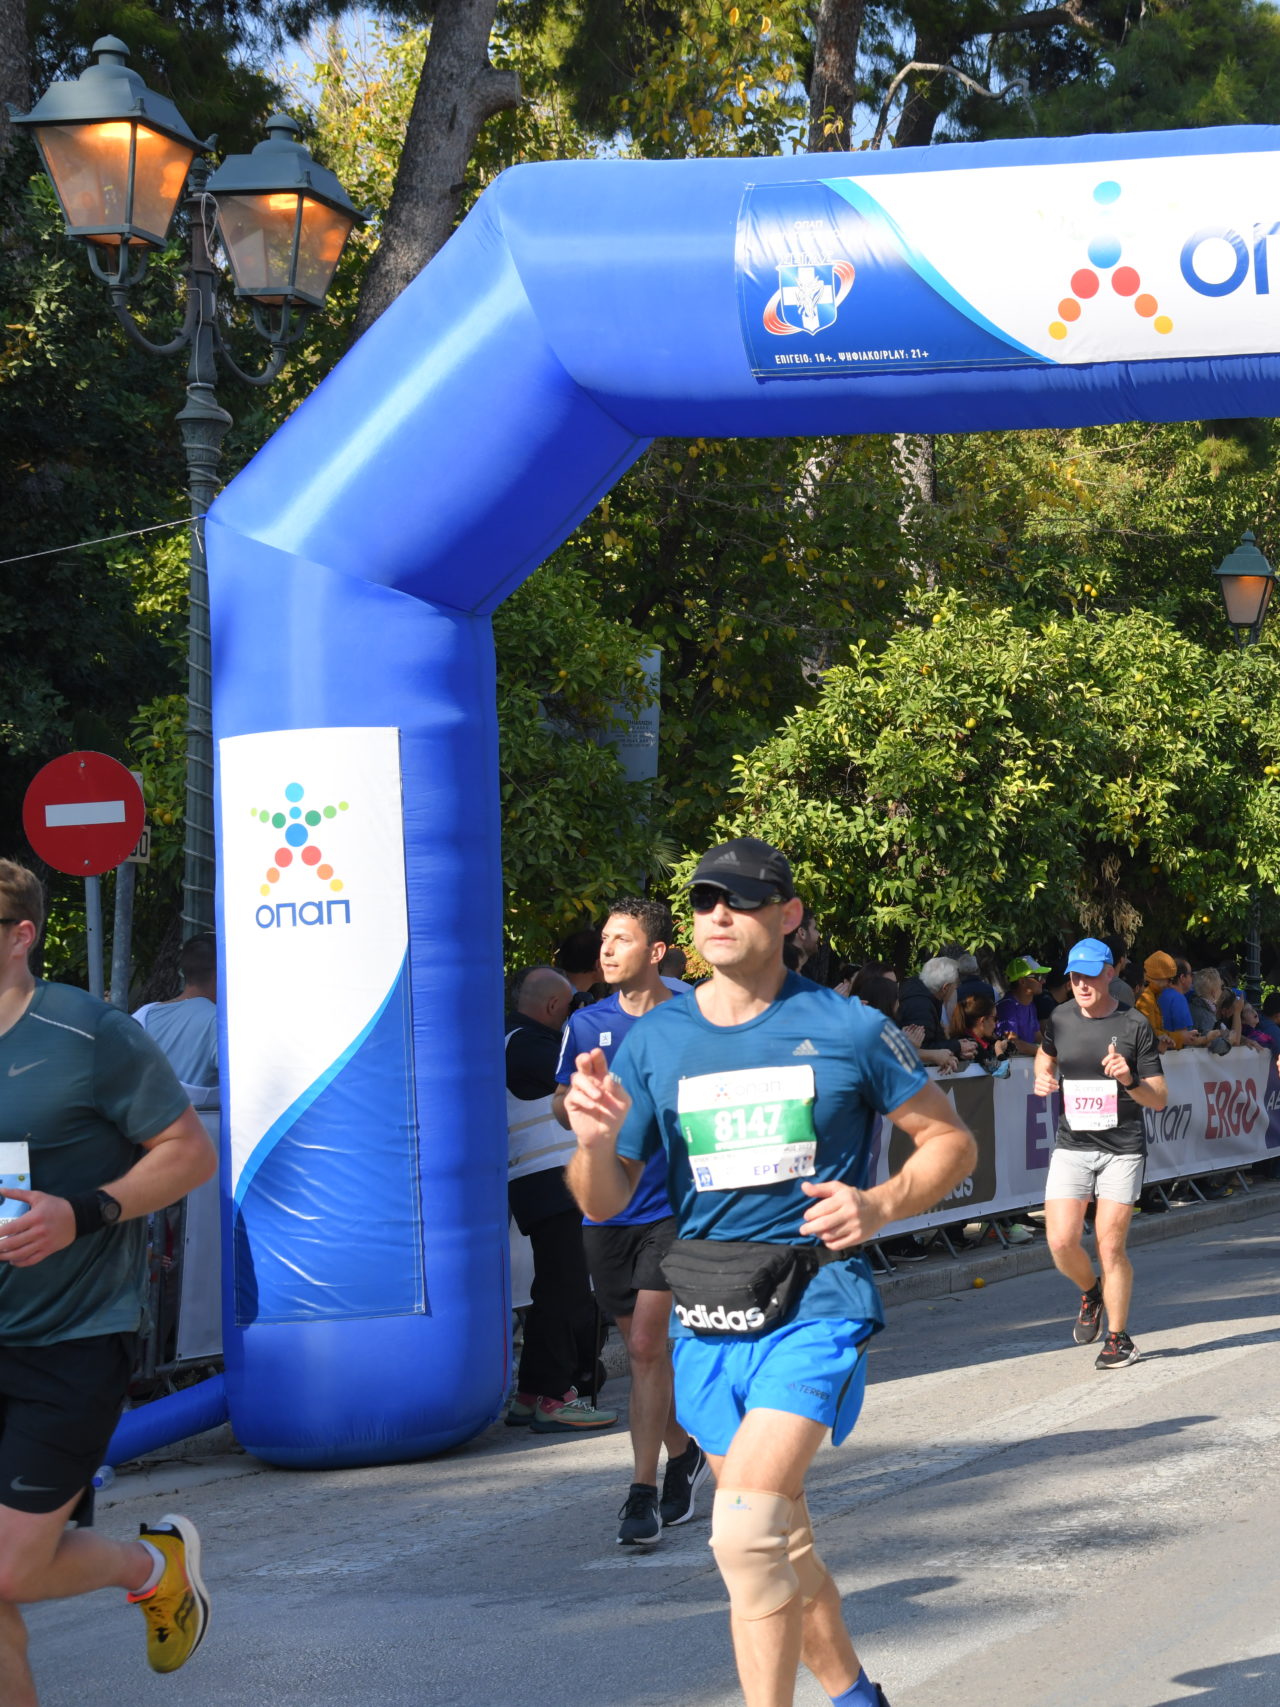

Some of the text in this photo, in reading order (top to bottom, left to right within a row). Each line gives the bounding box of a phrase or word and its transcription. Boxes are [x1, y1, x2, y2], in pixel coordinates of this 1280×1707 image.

[910, 348, 930, 359] 21+
[1075, 1097, 1103, 1110] 5779
[1203, 1077, 1260, 1140] ERGO
[714, 1103, 784, 1142] 8147
[674, 1304, 765, 1331] adidas
